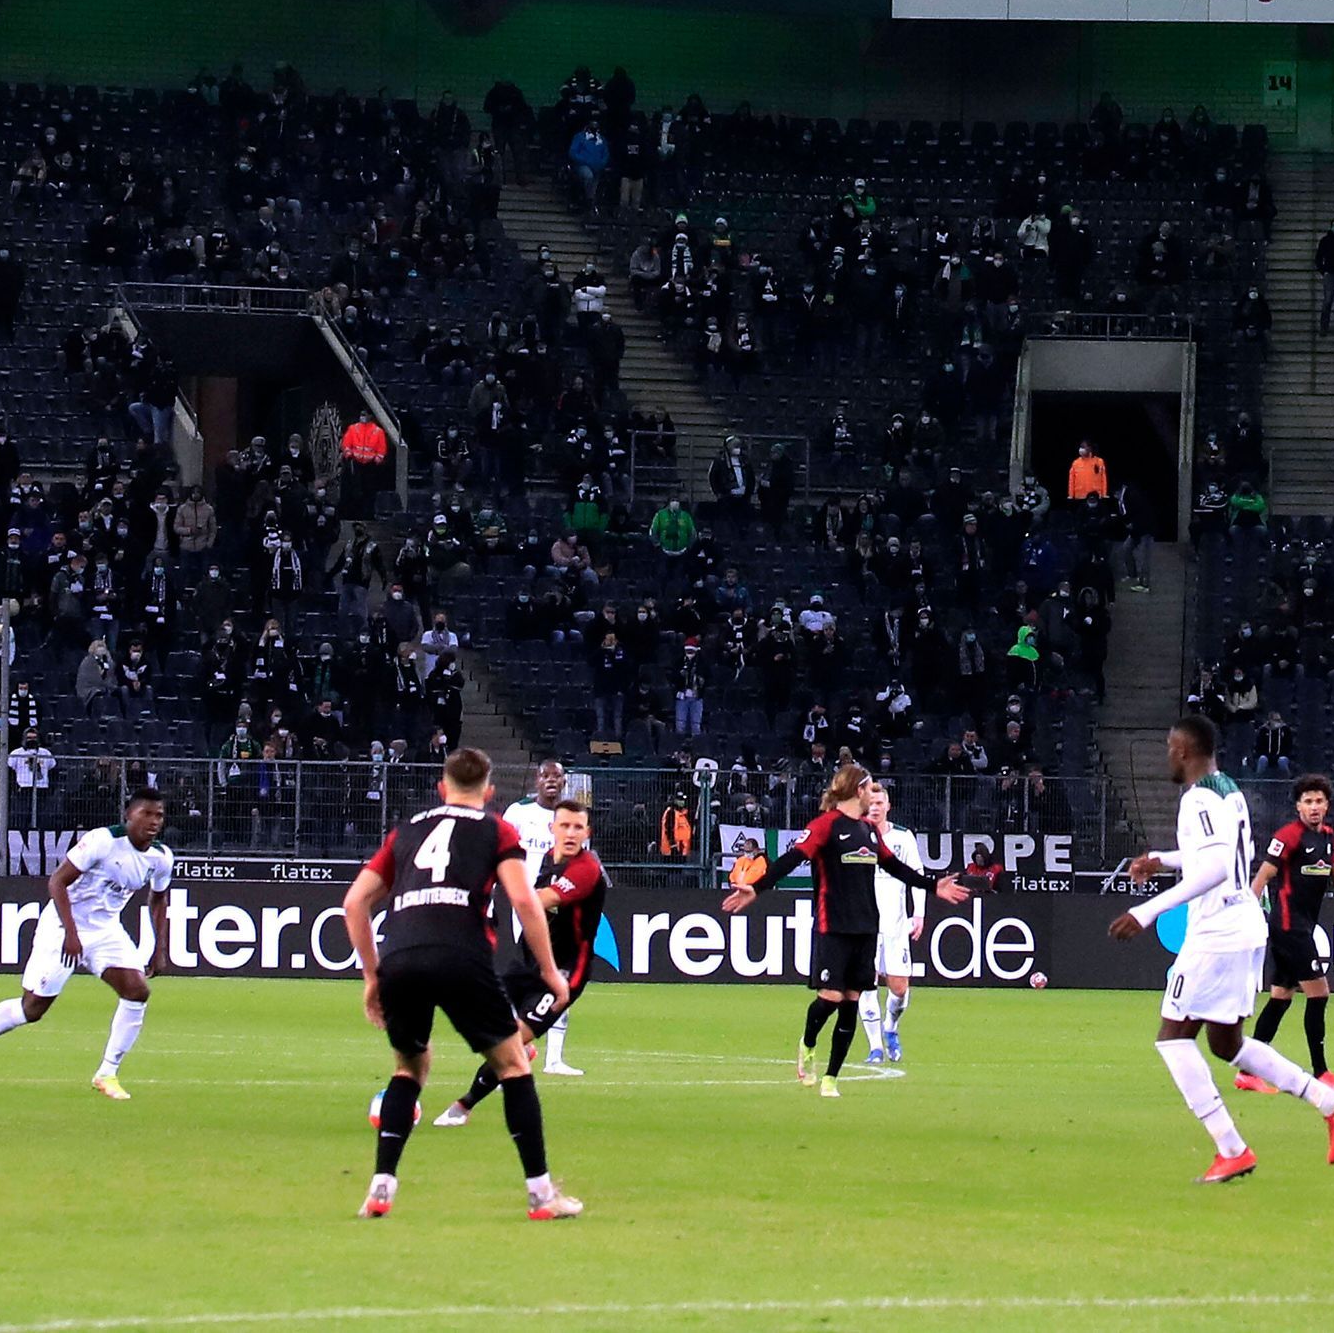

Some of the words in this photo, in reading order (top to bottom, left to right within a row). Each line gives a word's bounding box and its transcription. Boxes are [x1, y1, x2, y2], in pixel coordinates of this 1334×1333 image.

[1268, 75, 1292, 91] 14
[413, 818, 456, 883] 4
[528, 838, 553, 850] flat
[271, 863, 333, 880] flatex
[1011, 875, 1071, 892] flatex
[535, 992, 555, 1016] 8
